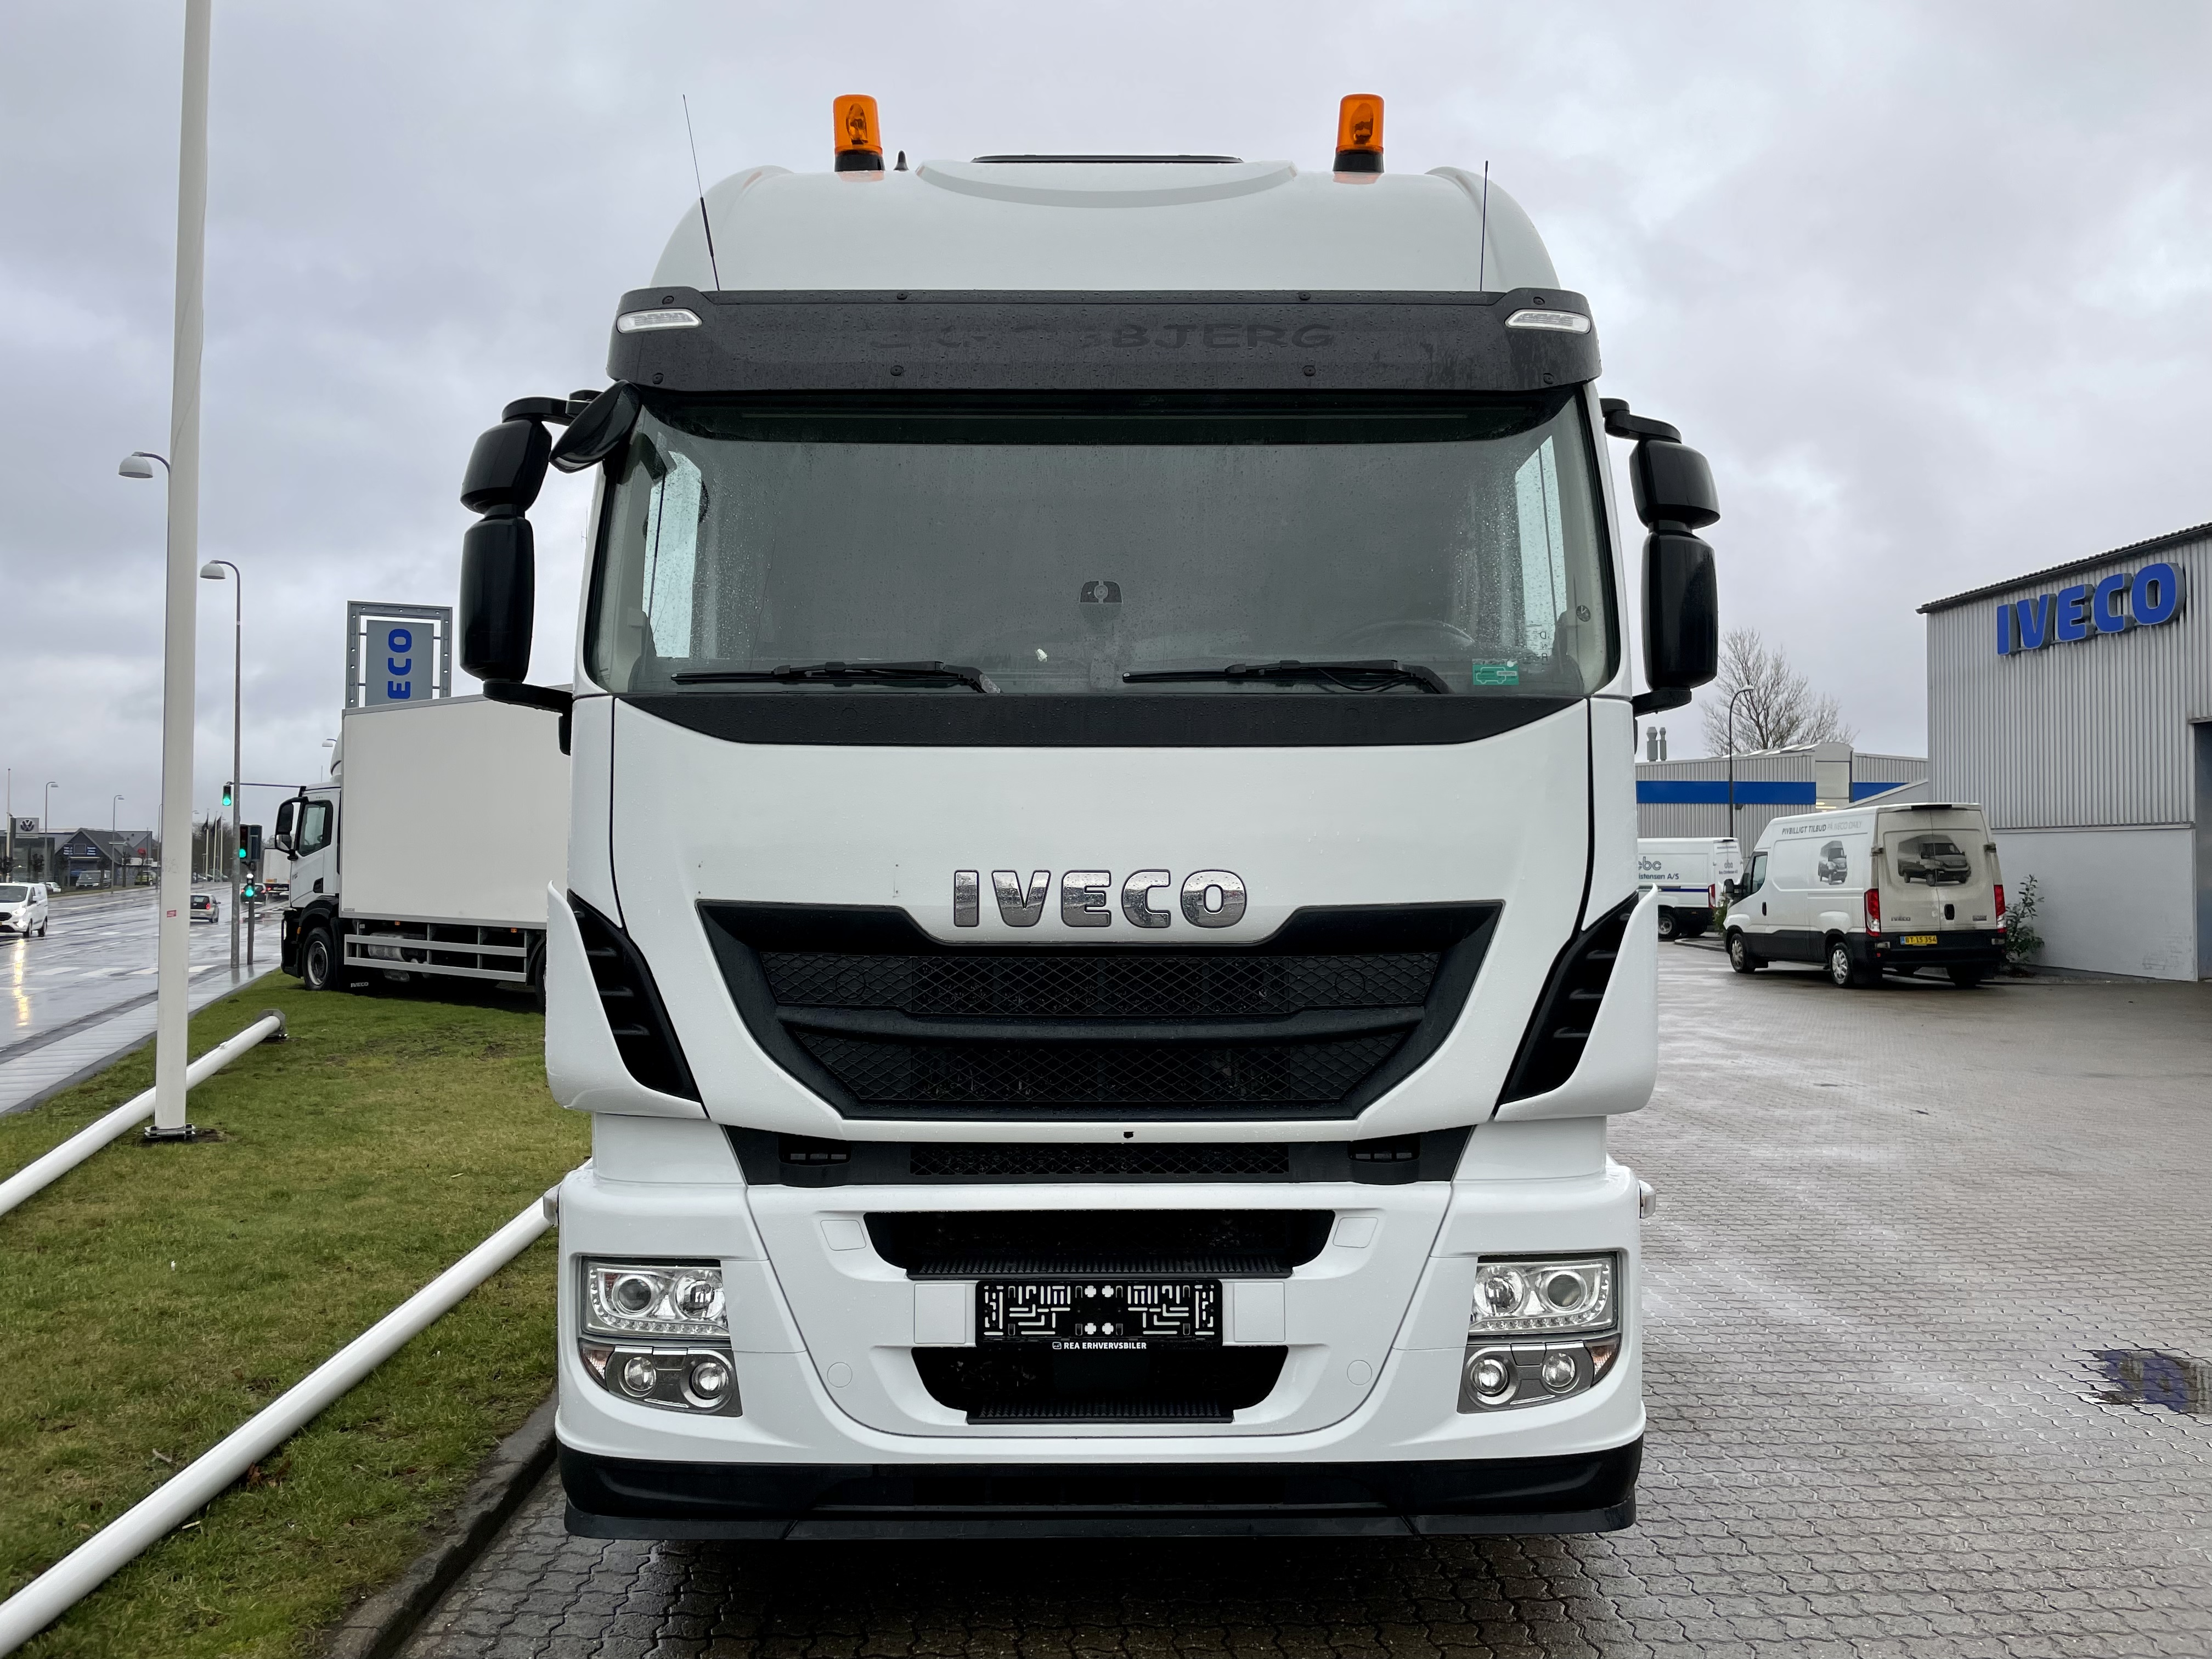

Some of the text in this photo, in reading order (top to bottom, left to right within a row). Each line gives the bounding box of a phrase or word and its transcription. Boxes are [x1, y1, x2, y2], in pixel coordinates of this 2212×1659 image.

[1997, 562, 2182, 656] IVECO
[388, 629, 412, 699] ECO
[953, 869, 1248, 928] IVECO
